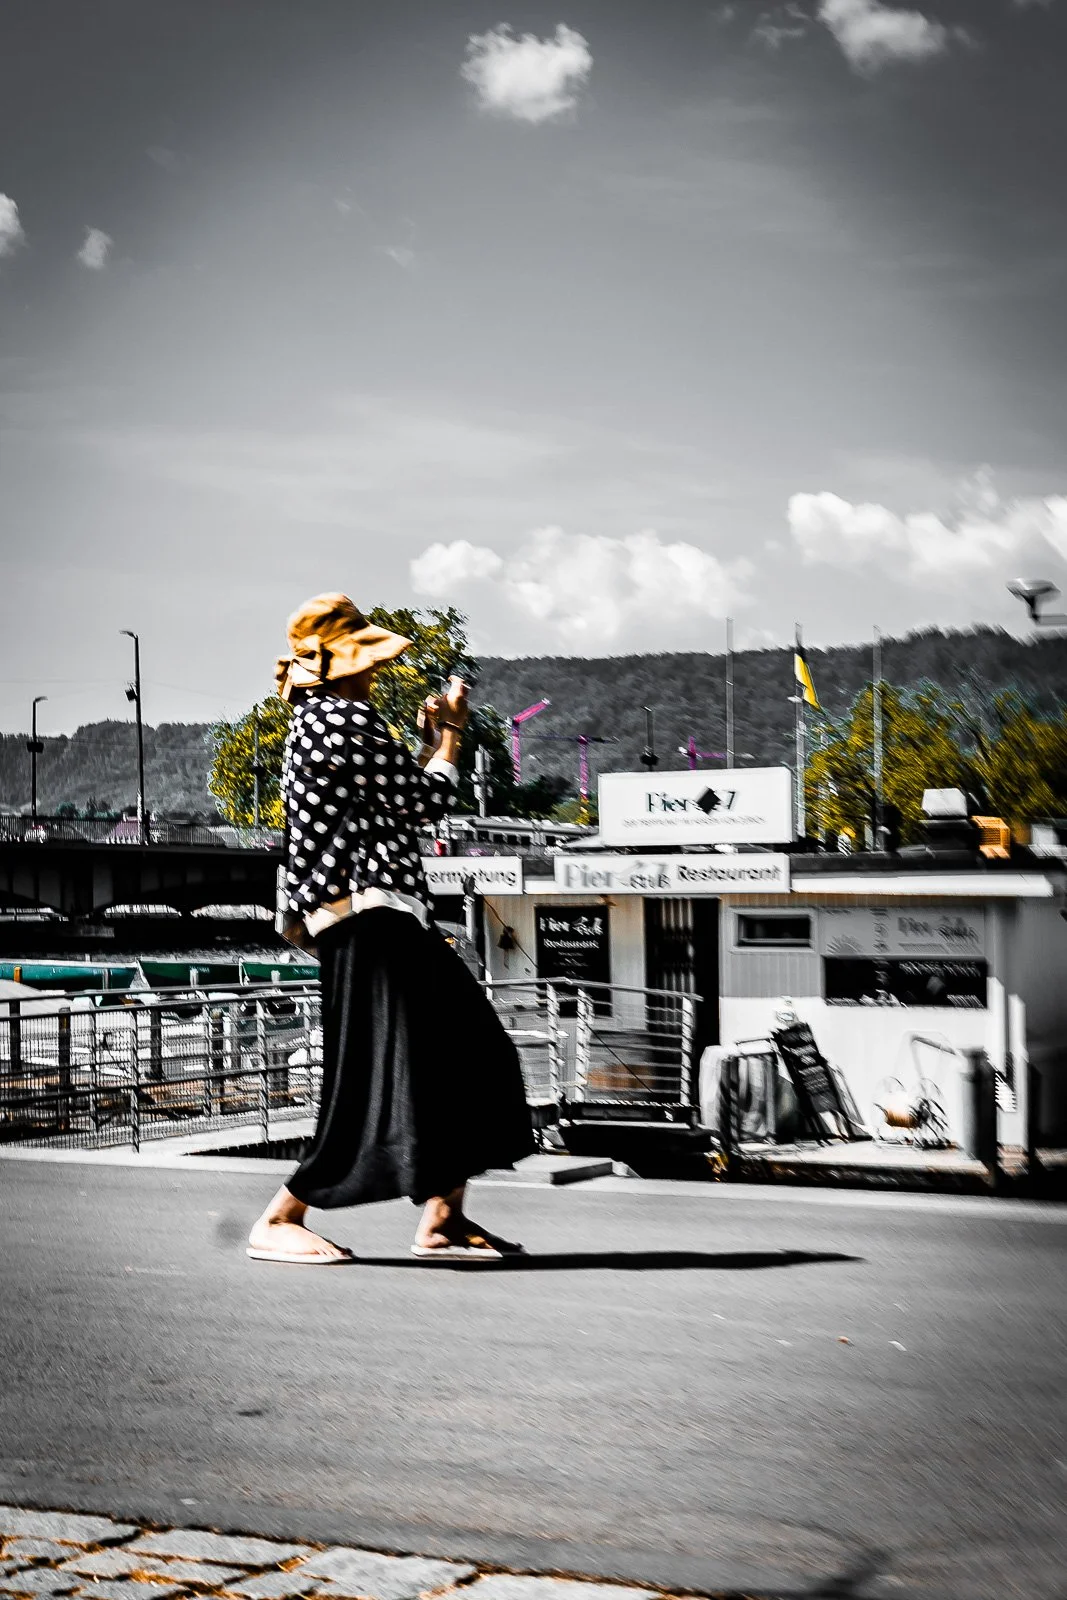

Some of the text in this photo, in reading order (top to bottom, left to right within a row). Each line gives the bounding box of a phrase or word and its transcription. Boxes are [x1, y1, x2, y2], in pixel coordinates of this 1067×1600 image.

[646, 791, 689, 812] Pier
[425, 866, 517, 886] ermietung
[564, 863, 614, 888] Pier
[678, 864, 781, 881] Restaurant
